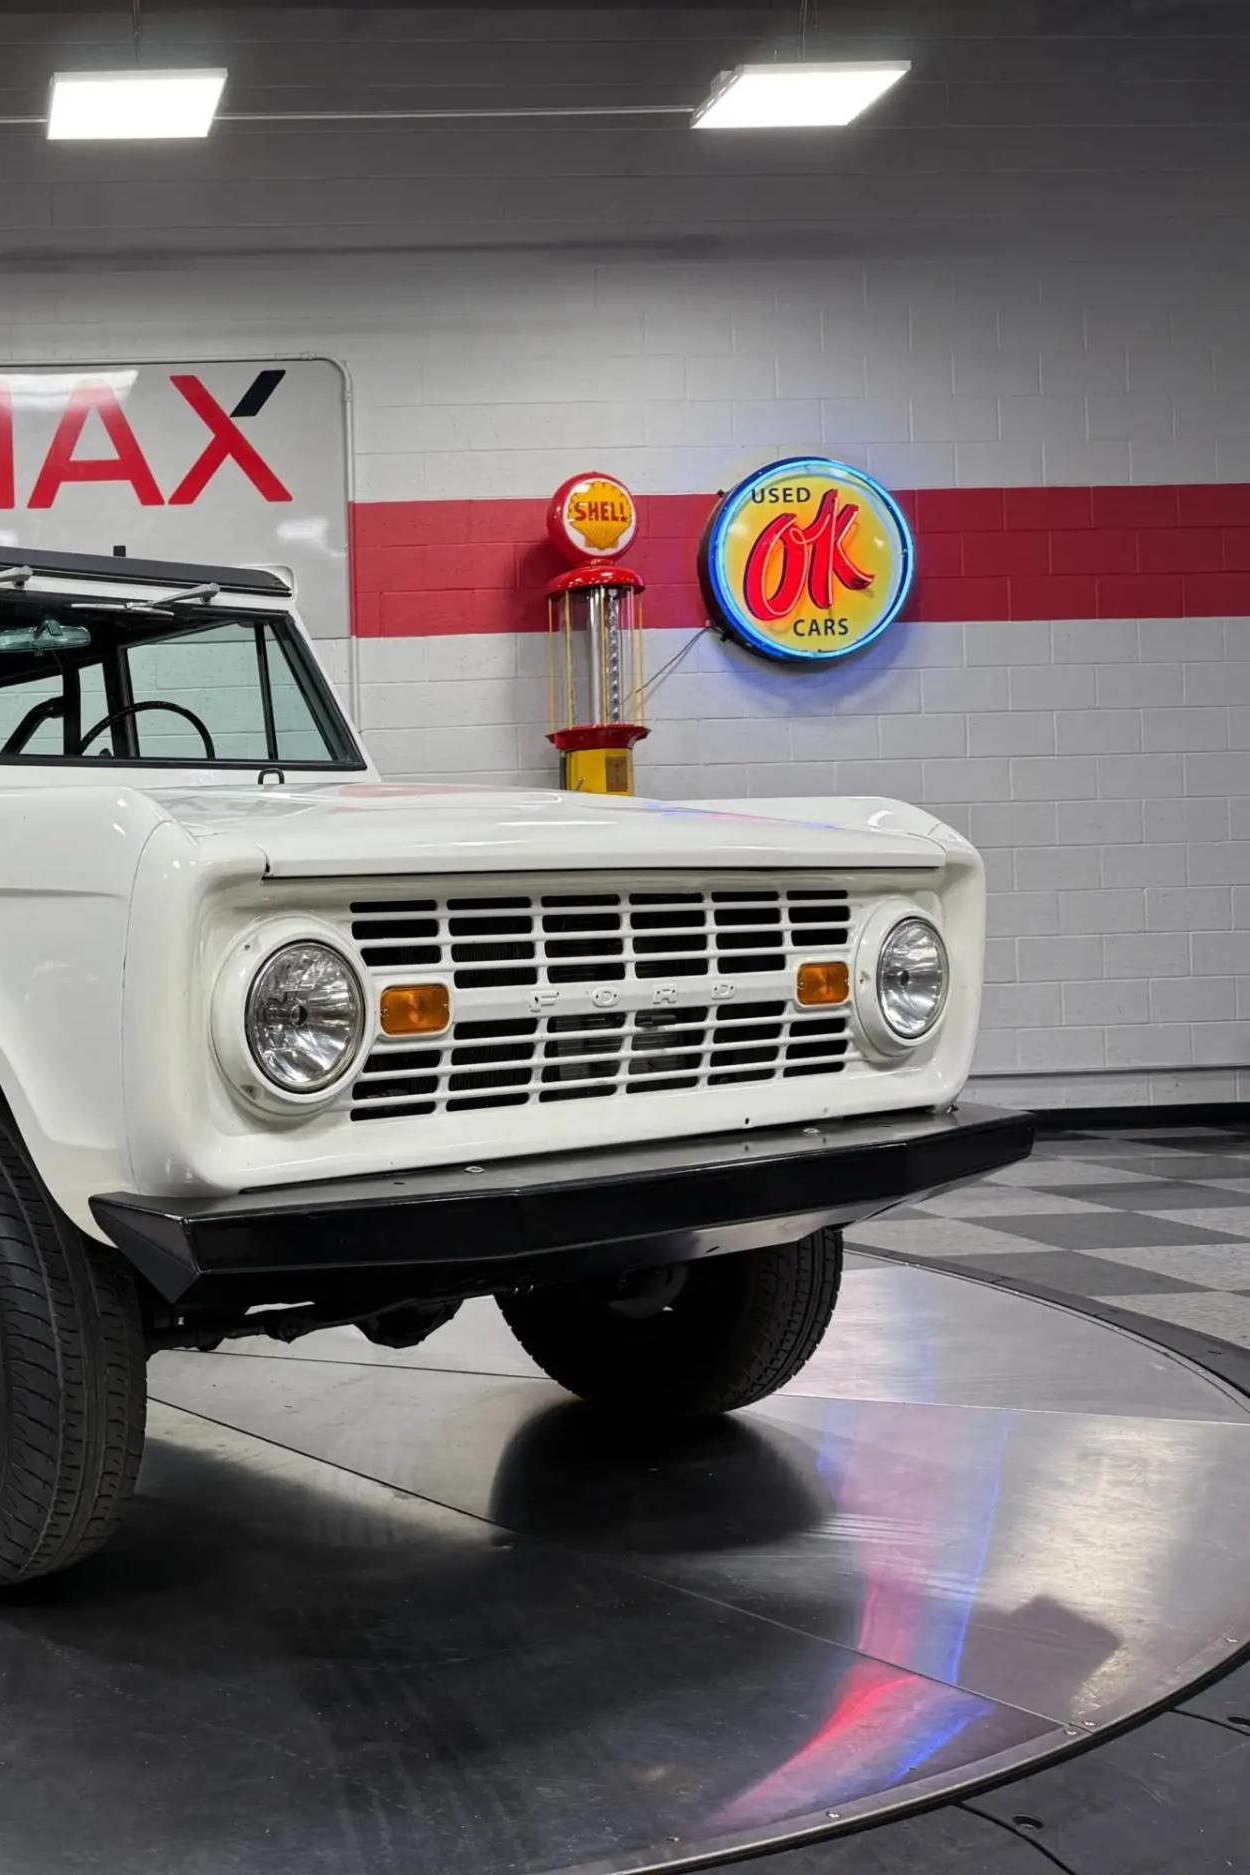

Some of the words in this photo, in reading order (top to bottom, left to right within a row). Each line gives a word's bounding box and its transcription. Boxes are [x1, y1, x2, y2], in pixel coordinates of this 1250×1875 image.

[752, 486, 812, 504] USED
[573, 500, 629, 523] SHELL
[743, 489, 875, 621] OK
[793, 618, 849, 636] CARS
[529, 982, 734, 1013] FORD
